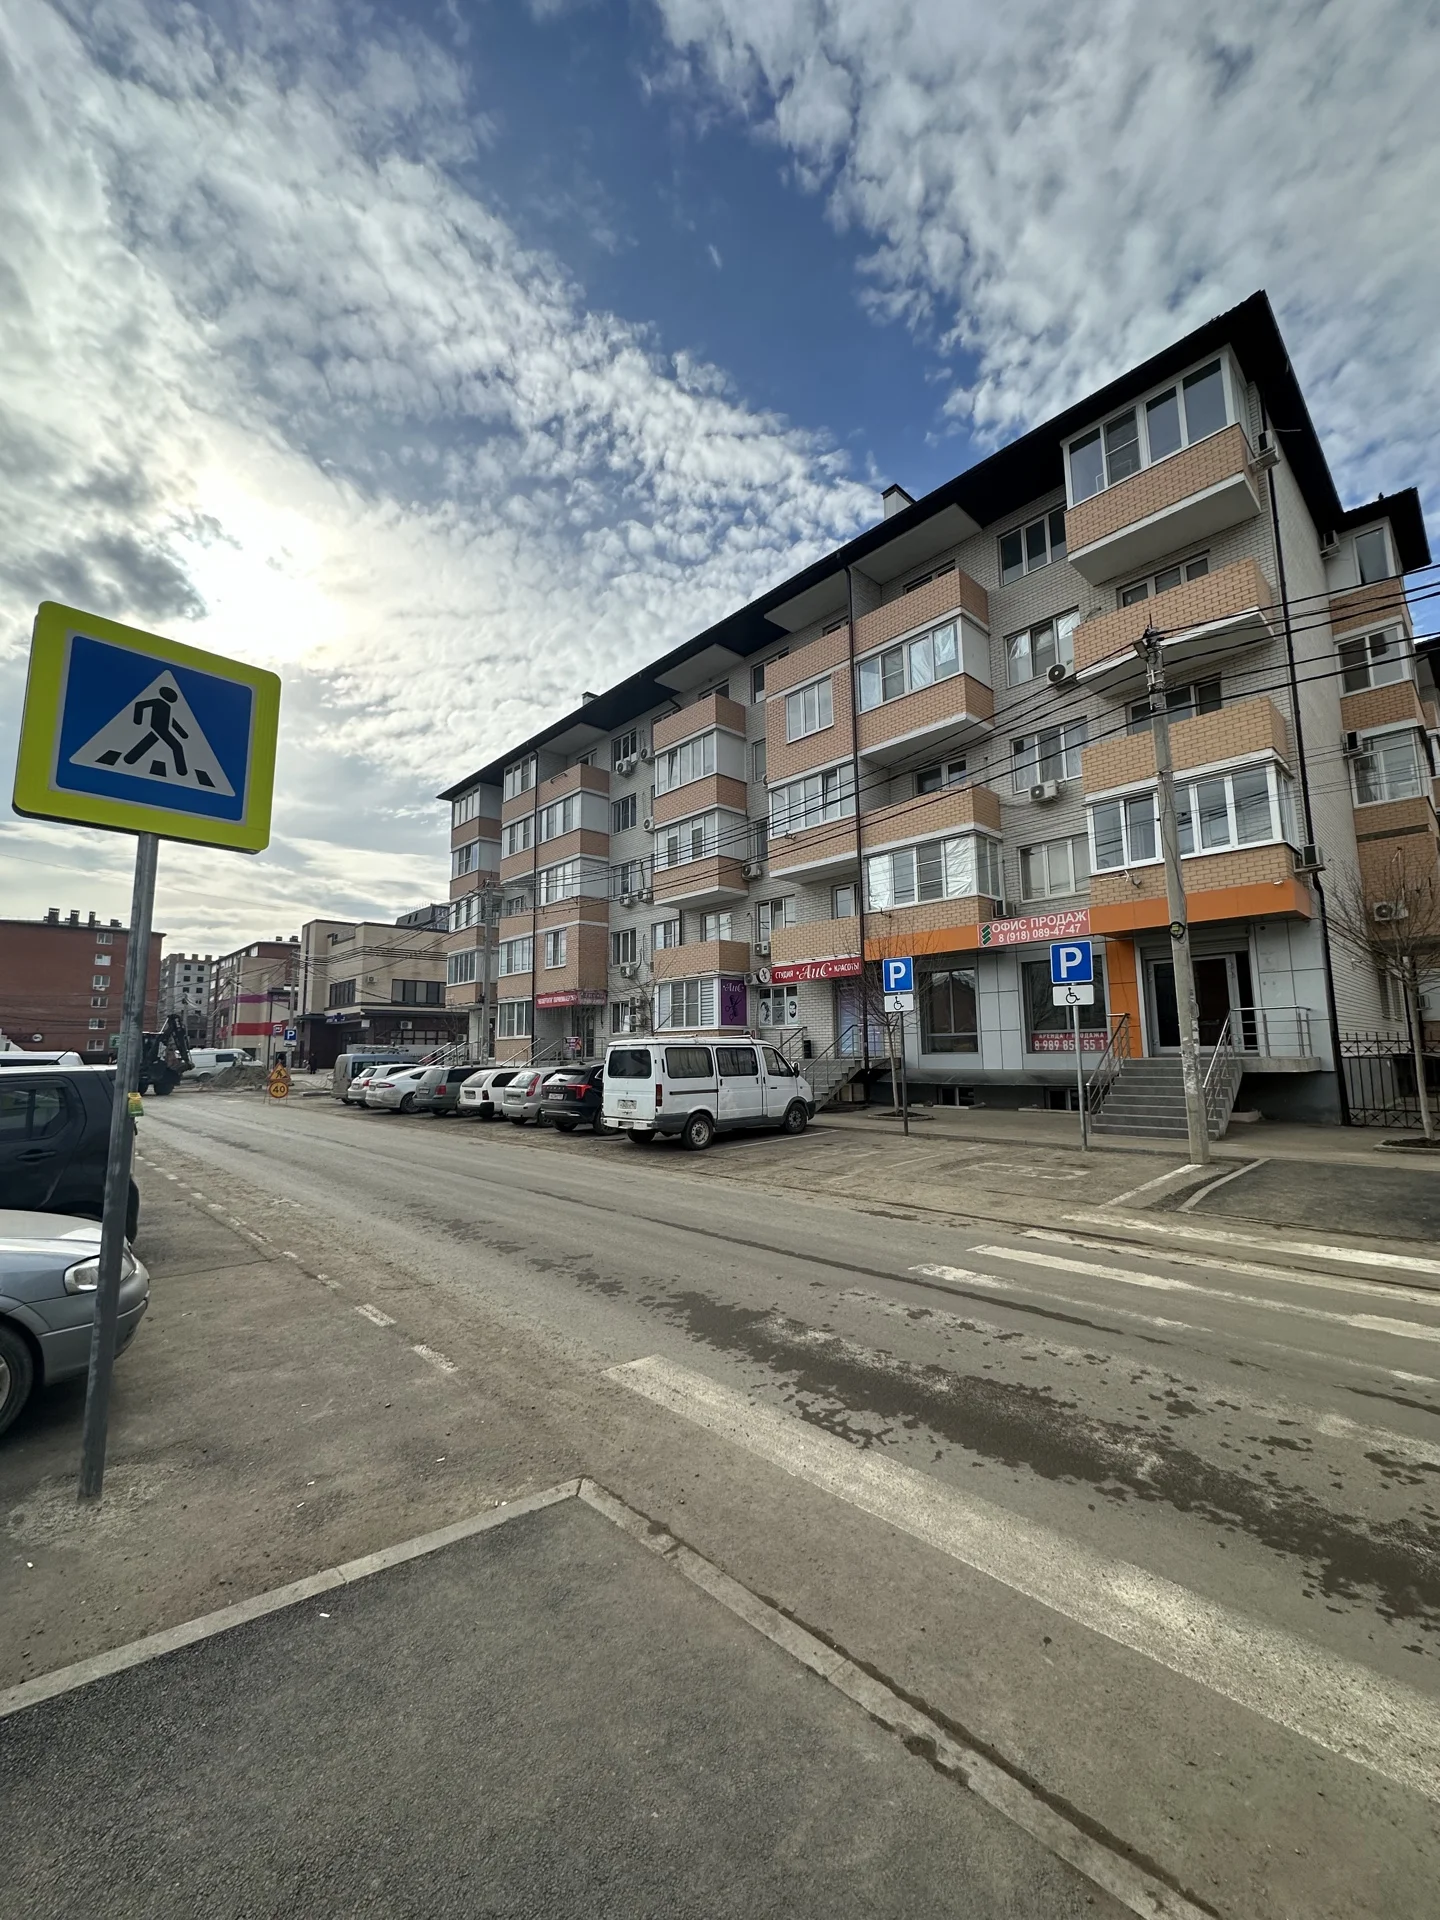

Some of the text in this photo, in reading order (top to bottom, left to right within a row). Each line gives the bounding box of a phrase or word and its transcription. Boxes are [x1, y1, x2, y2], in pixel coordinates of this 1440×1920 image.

[992, 910, 1087, 933] ОФИС ПРОДАЖ
[998, 923, 1081, 943] 8 (918) 089-47-47
[775, 970, 794, 979] СТУДИЯ
[833, 962, 860, 973] КРАСОТЫ
[1060, 946, 1082, 978] P
[889, 961, 906, 989] P
[287, 1030, 295, 1040] P
[1034, 1040, 1040, 1051] 8
[1042, 1040, 1060, 1051] 989
[1083, 1039, 1096, 1051] 55
